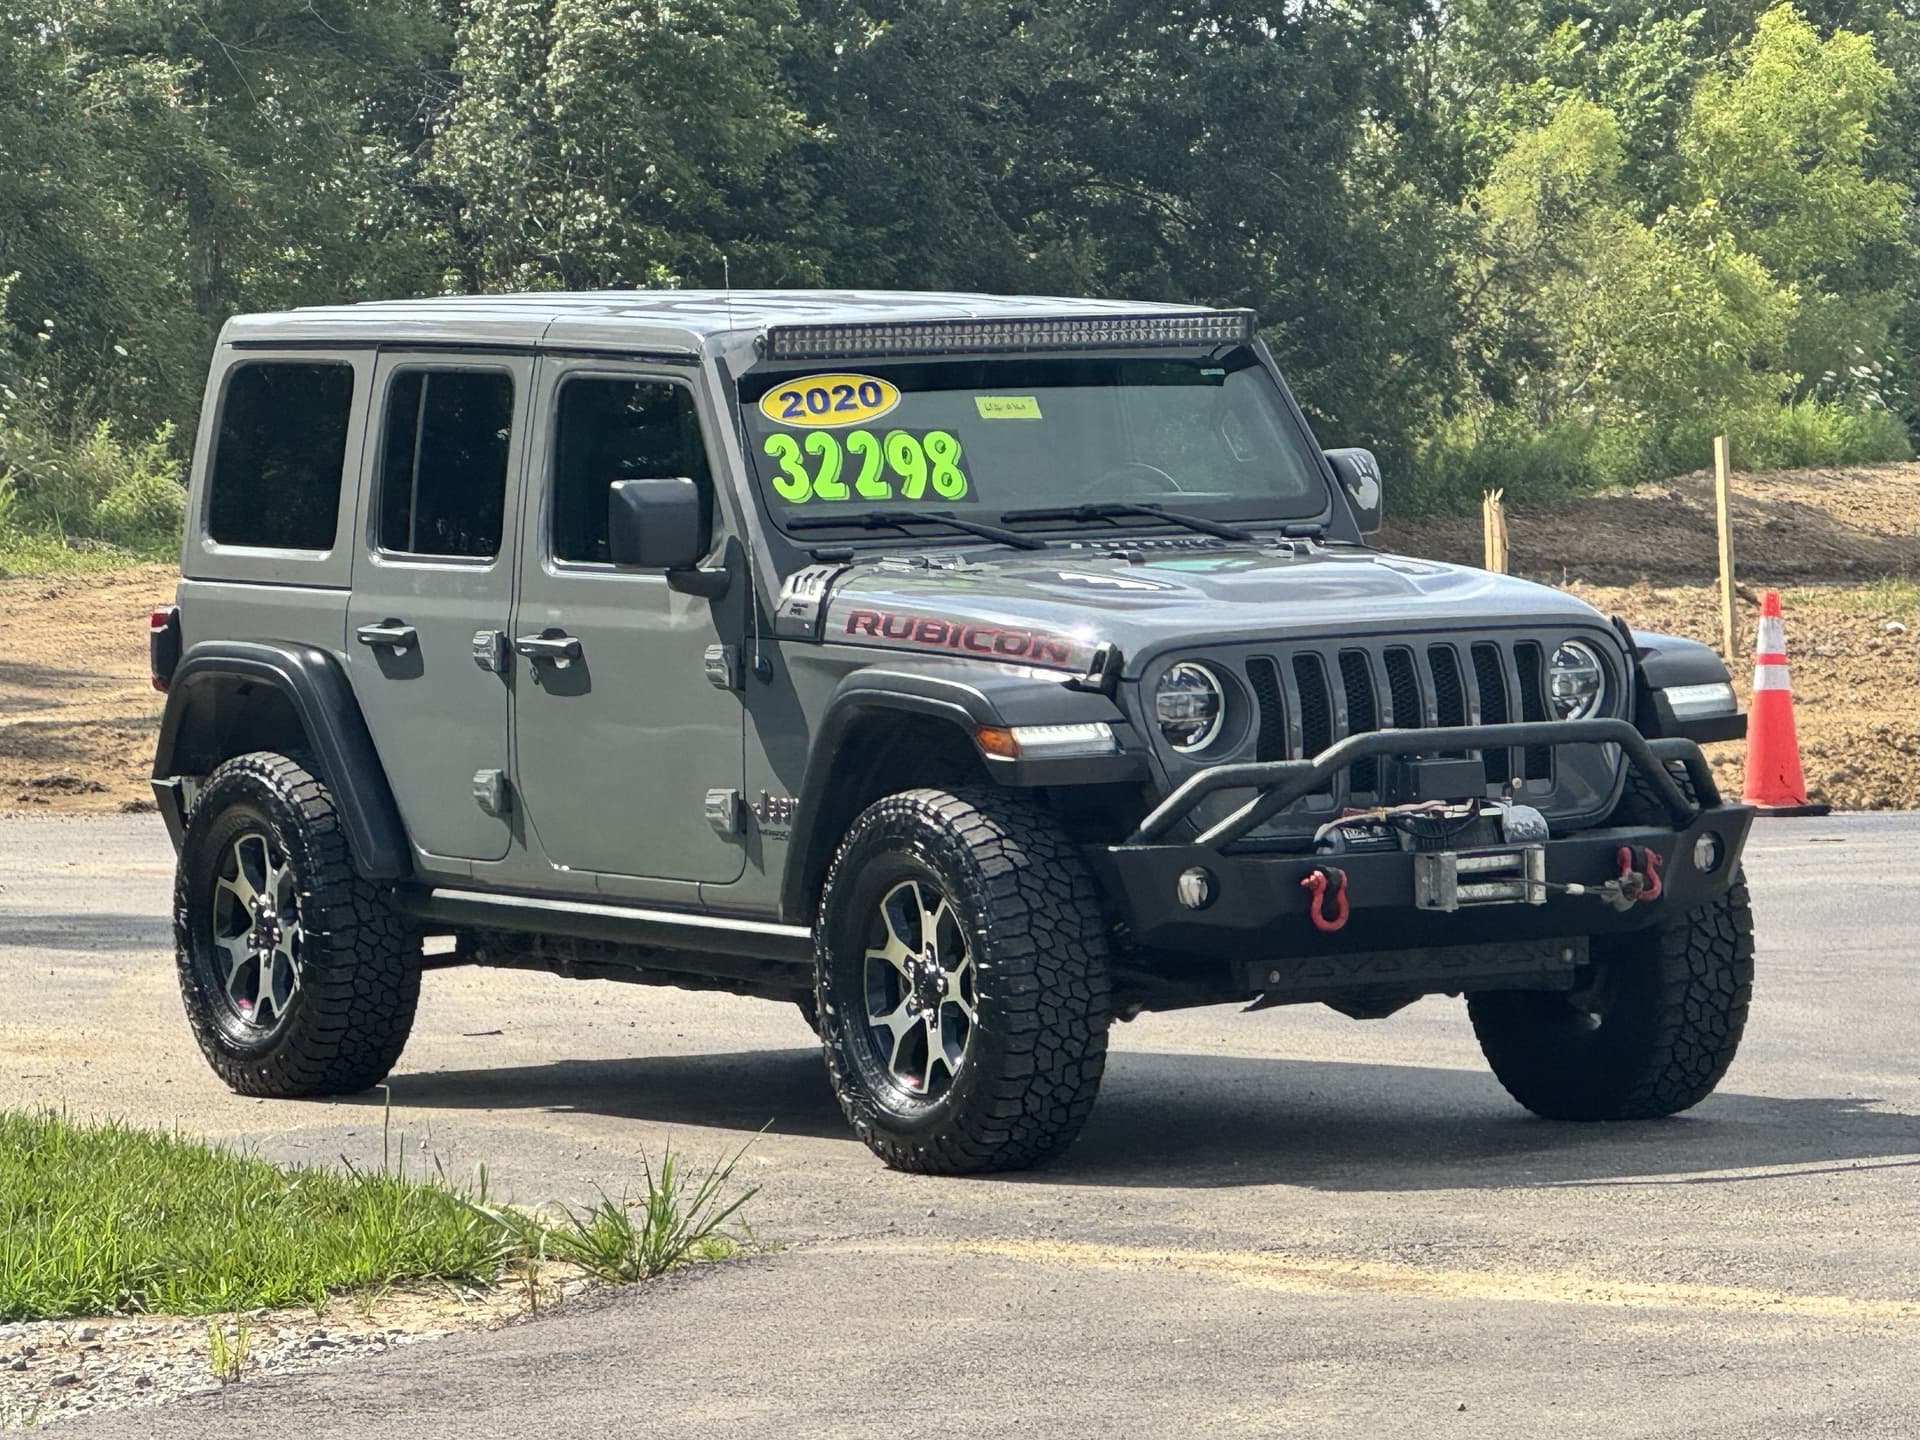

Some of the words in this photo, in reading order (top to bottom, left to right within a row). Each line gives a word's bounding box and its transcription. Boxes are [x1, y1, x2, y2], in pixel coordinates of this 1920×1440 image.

[780, 381, 882, 418] 2020
[764, 430, 968, 503] 32298
[846, 609, 1073, 663] RUBICON
